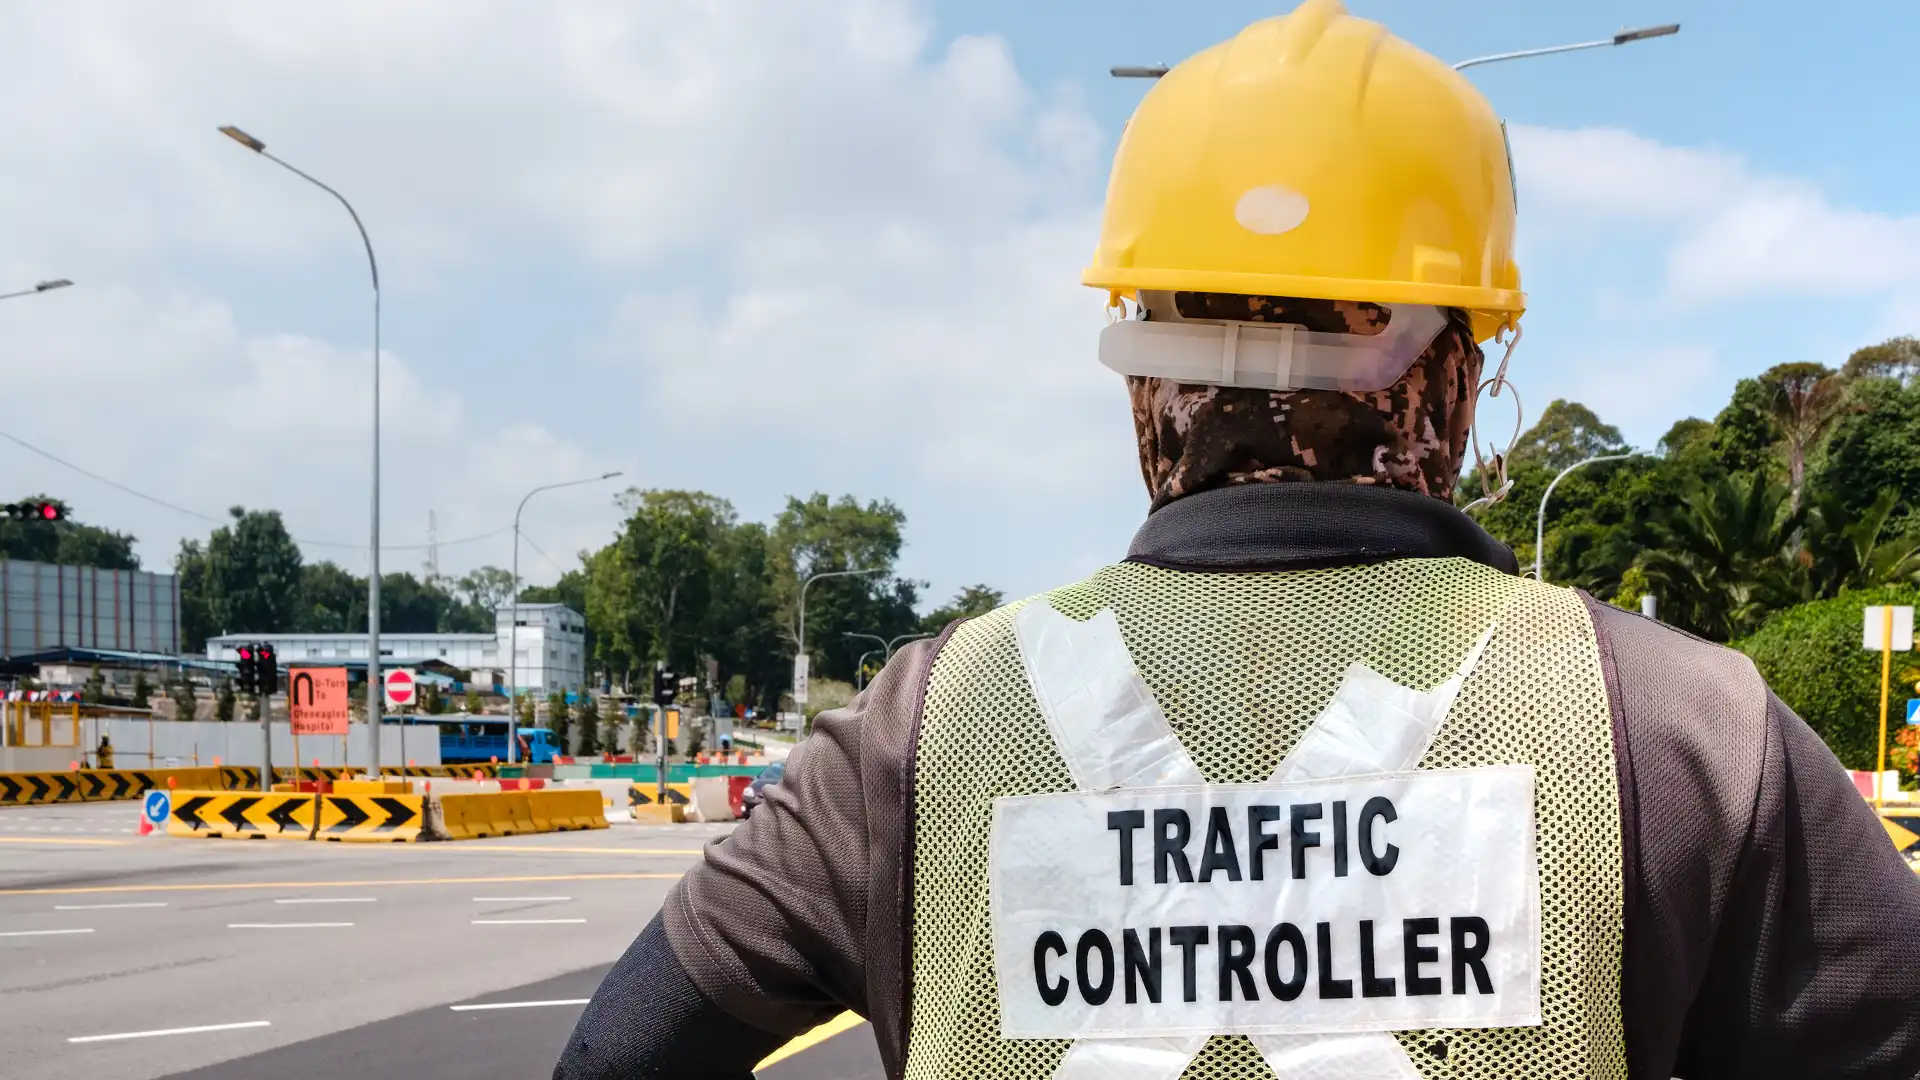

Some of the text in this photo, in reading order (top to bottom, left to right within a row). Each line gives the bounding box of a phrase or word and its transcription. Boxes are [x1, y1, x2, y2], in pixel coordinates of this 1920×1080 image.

[293, 721, 334, 731] Hospital
[1107, 796, 1400, 886] TRAFFIC
[1033, 916, 1495, 1007] CONTROLLER
